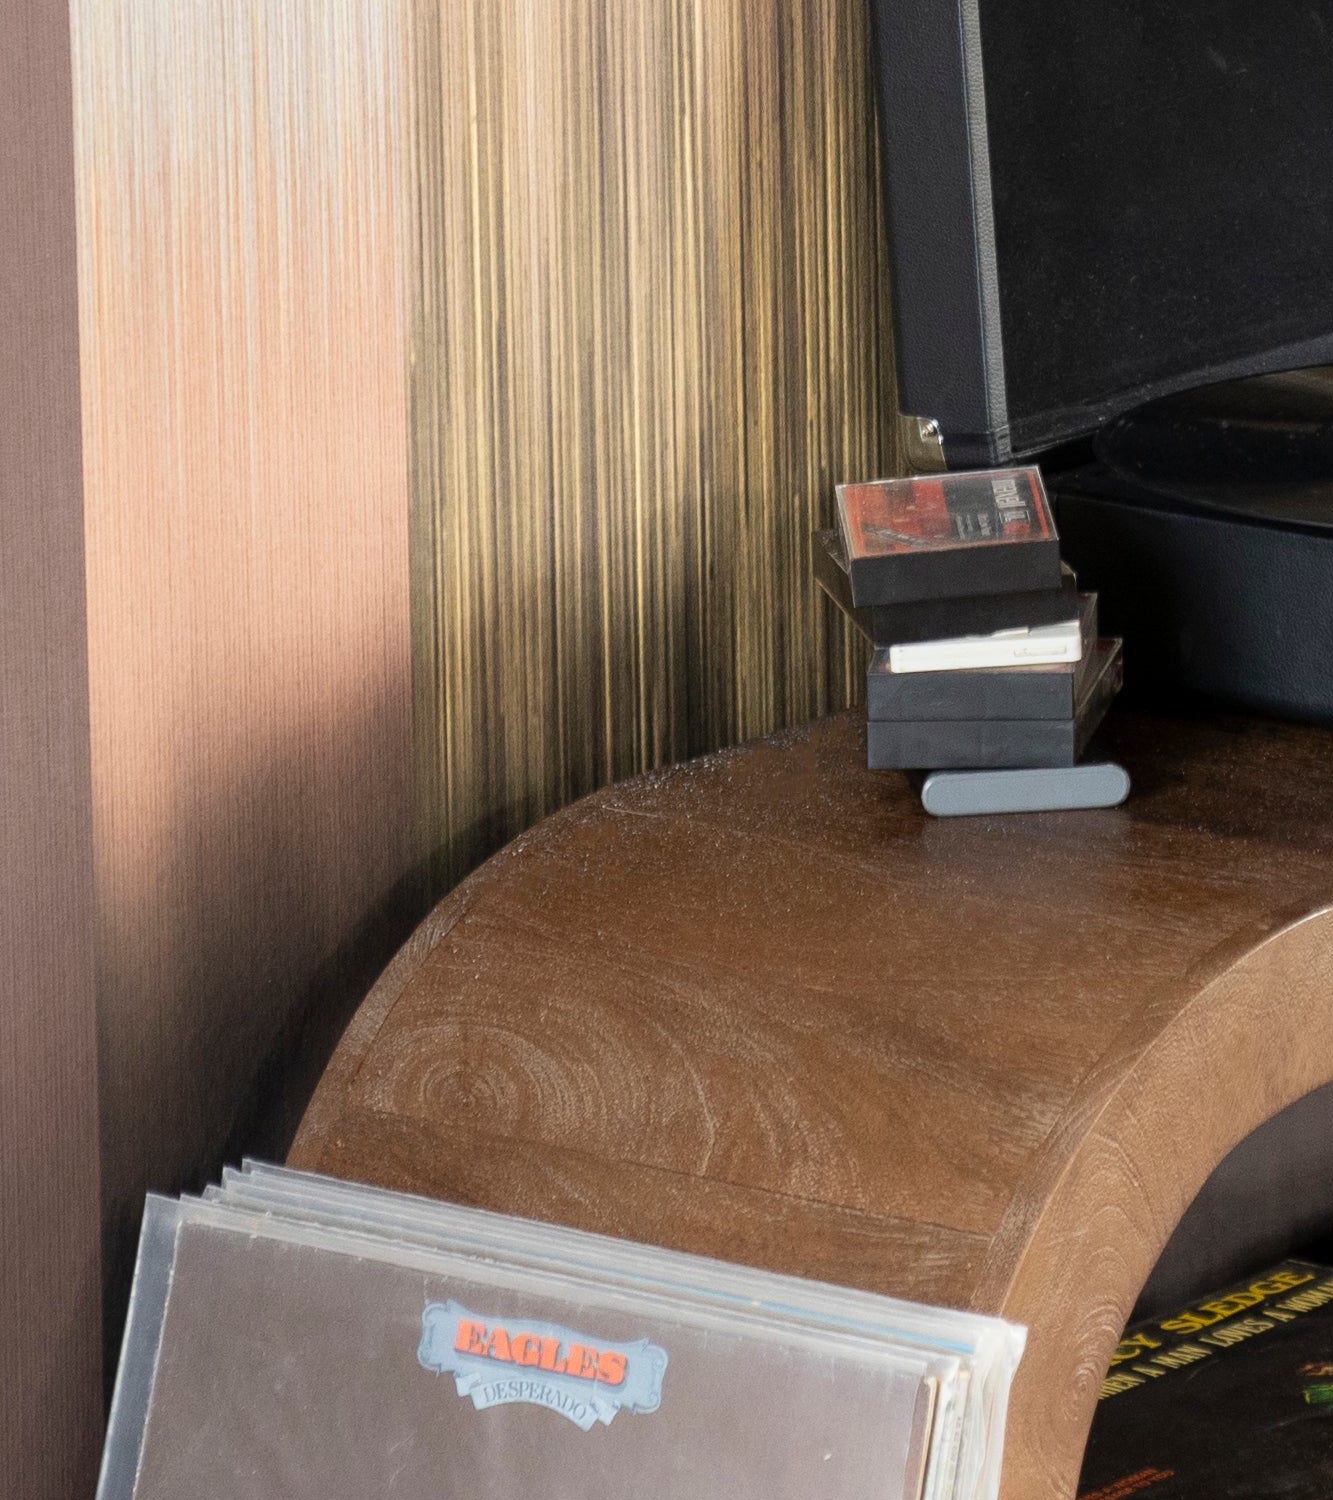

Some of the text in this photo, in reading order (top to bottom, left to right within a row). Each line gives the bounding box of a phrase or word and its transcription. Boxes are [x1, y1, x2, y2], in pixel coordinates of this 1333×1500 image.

[1161, 1270, 1315, 1335] SLEDGE
[454, 1316, 628, 1386] EAGLES
[1132, 1364, 1167, 1379] A
[1150, 1342, 1213, 1370] MAN
[1198, 1315, 1275, 1348] LOVES
[1261, 1306, 1297, 1323] A
[482, 1379, 588, 1421] DESPERADO
